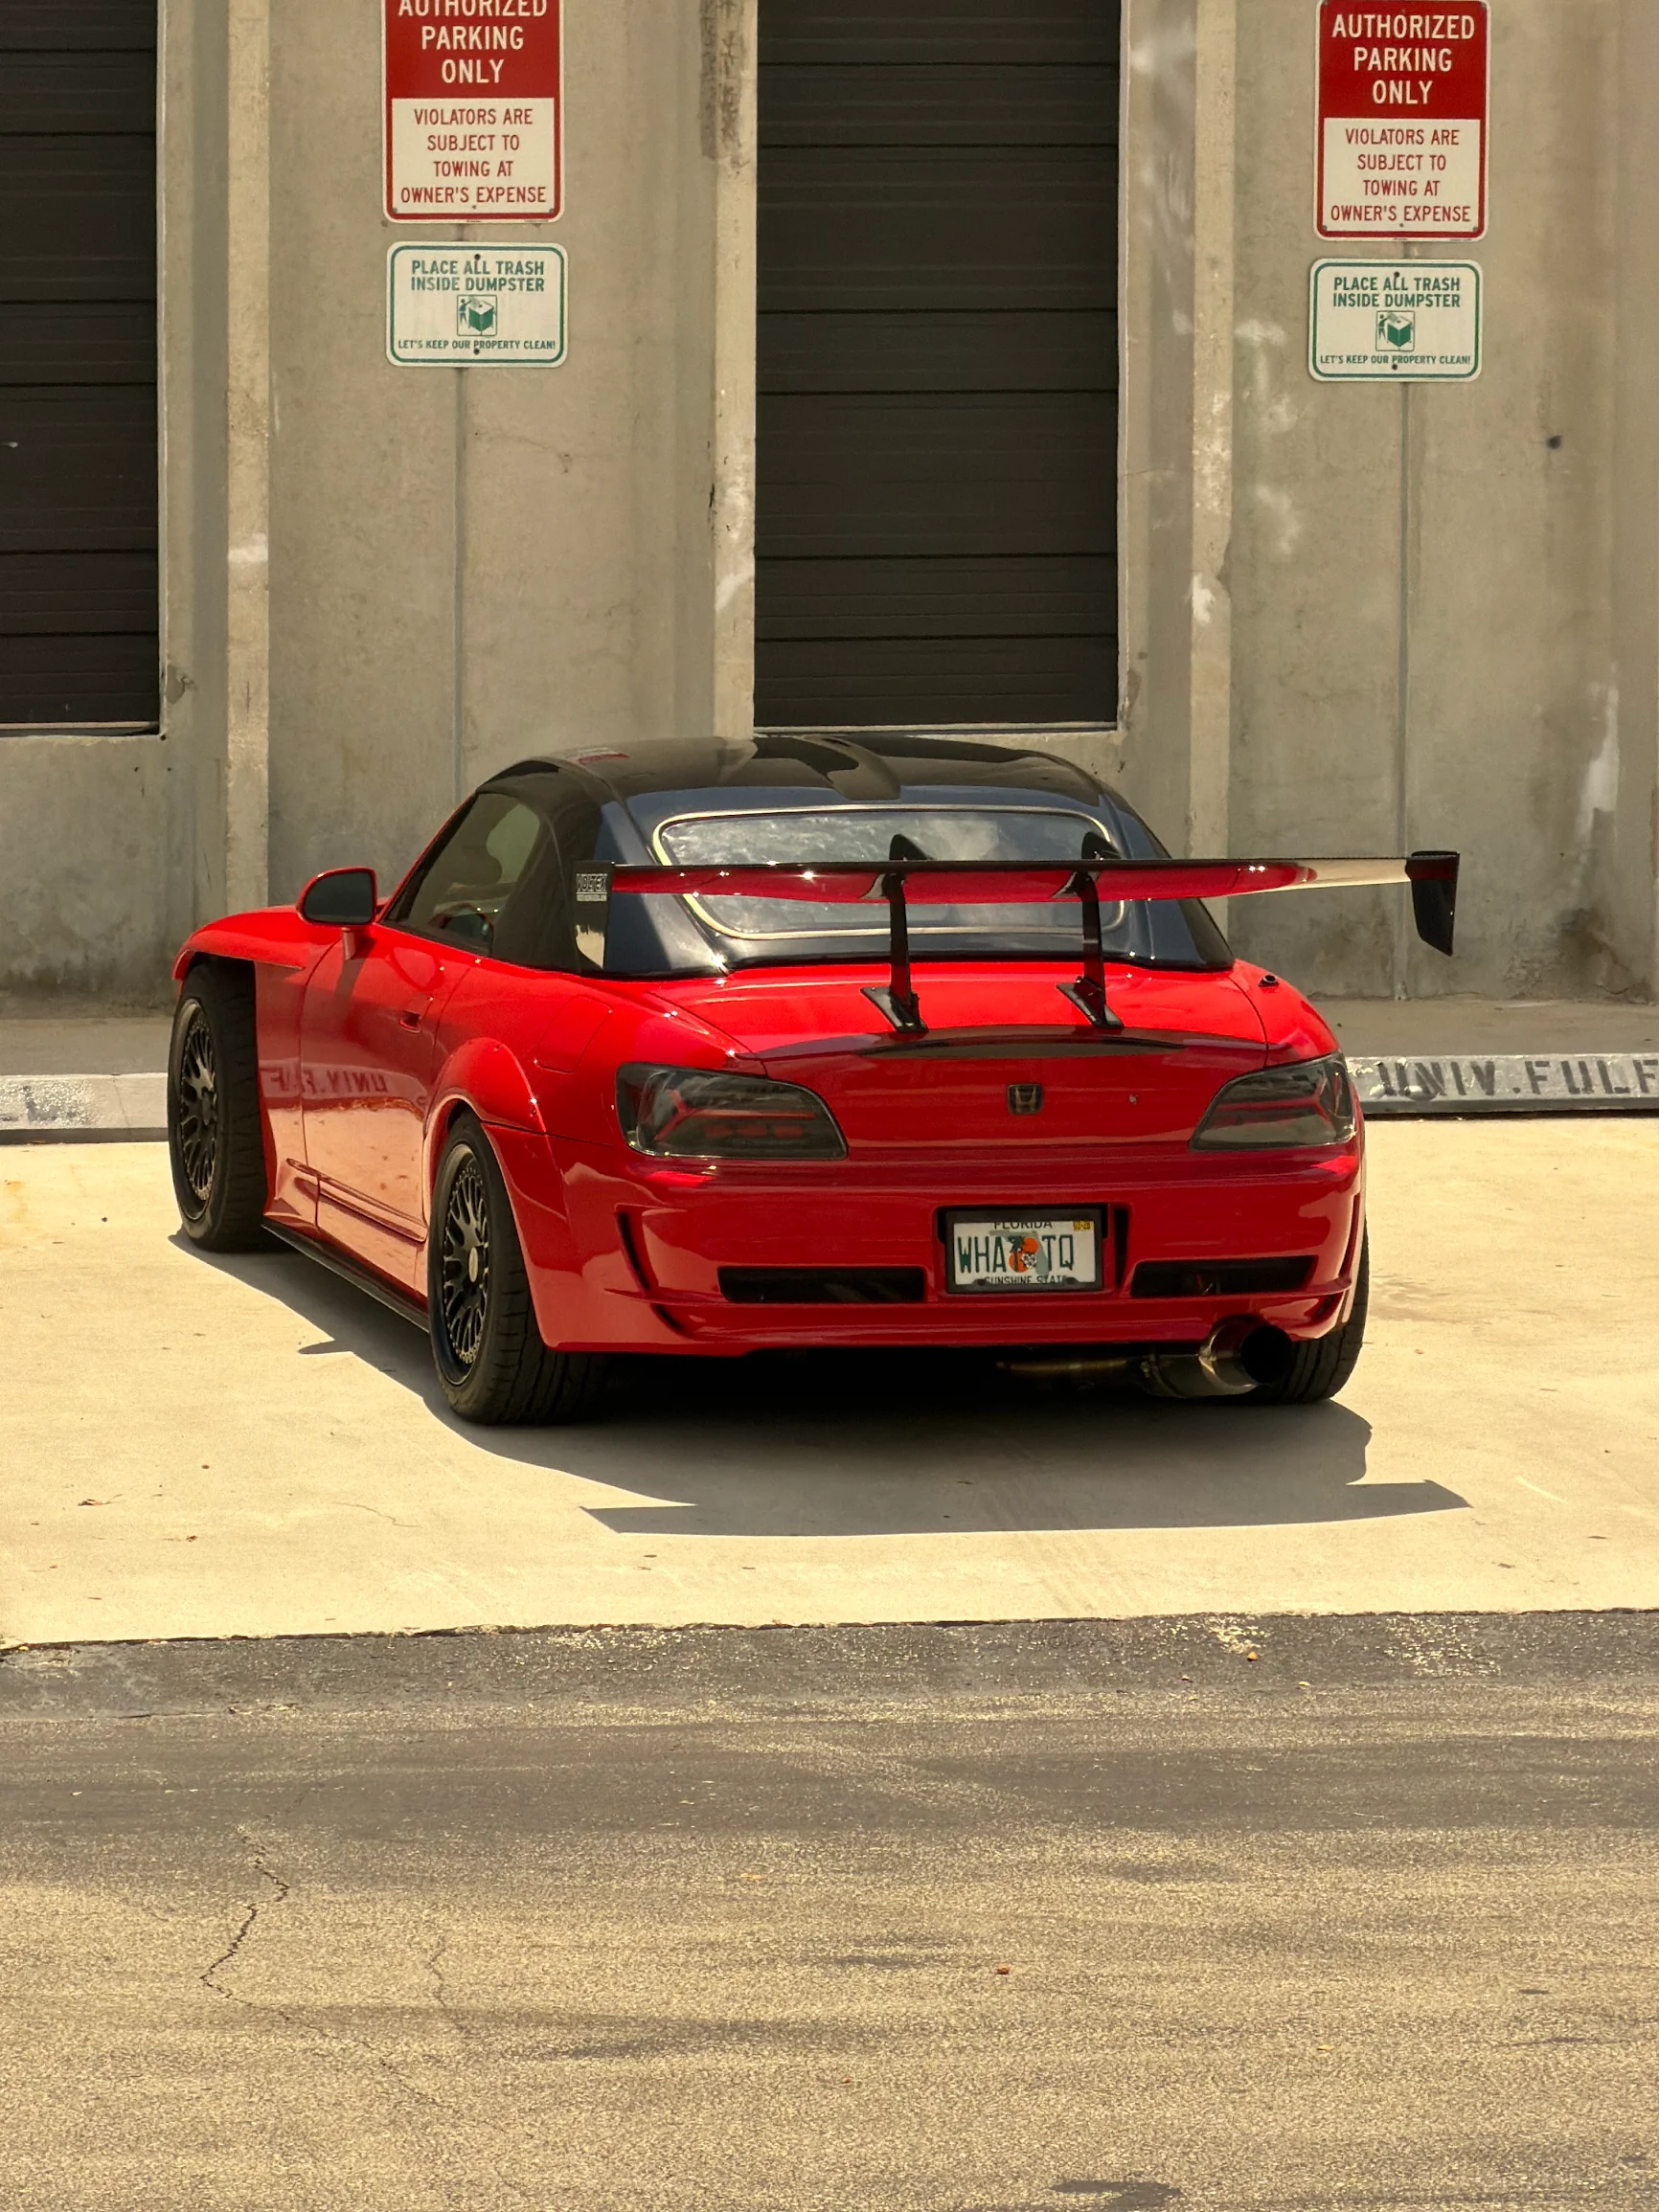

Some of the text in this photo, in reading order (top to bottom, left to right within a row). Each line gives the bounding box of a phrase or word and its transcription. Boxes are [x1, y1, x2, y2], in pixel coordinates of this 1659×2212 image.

[398, 0, 548, 16] AUTHORIZED
[1331, 13, 1475, 39] AUTHORIZED
[421, 26, 524, 50] PARKING
[1353, 47, 1452, 72] PARKING
[442, 59, 505, 83] ONLY
[1372, 80, 1433, 104] ONLY
[414, 108, 534, 125] VIOLATORS ARE
[427, 134, 519, 151] SUBJECT TO
[1345, 129, 1460, 146] VIOLATORS ARE
[433, 161, 513, 177] TOWING AT
[1357, 154, 1446, 170] SUBJECT TO
[400, 186, 547, 203] OWNER'S EXPENSE
[1363, 179, 1441, 196] TOWING AT
[1330, 205, 1471, 222] OWNER'S EXPENSE
[411, 260, 544, 275] PLACE ALL TRASH
[411, 277, 544, 292] INSIDE DUMPSTER
[1333, 277, 1461, 291] PLACE ALL TRASH
[1333, 293, 1461, 307] INSIDE DUMPSTER
[398, 340, 556, 350] LET'S KEEP OUR PROPERTY CLEAN!
[1320, 355, 1471, 364] LET'S KEEP OUR PROPERTY CLEAN!
[993, 1221, 1053, 1230] FLORIDA
[1041, 1234, 1075, 1272] TQ
